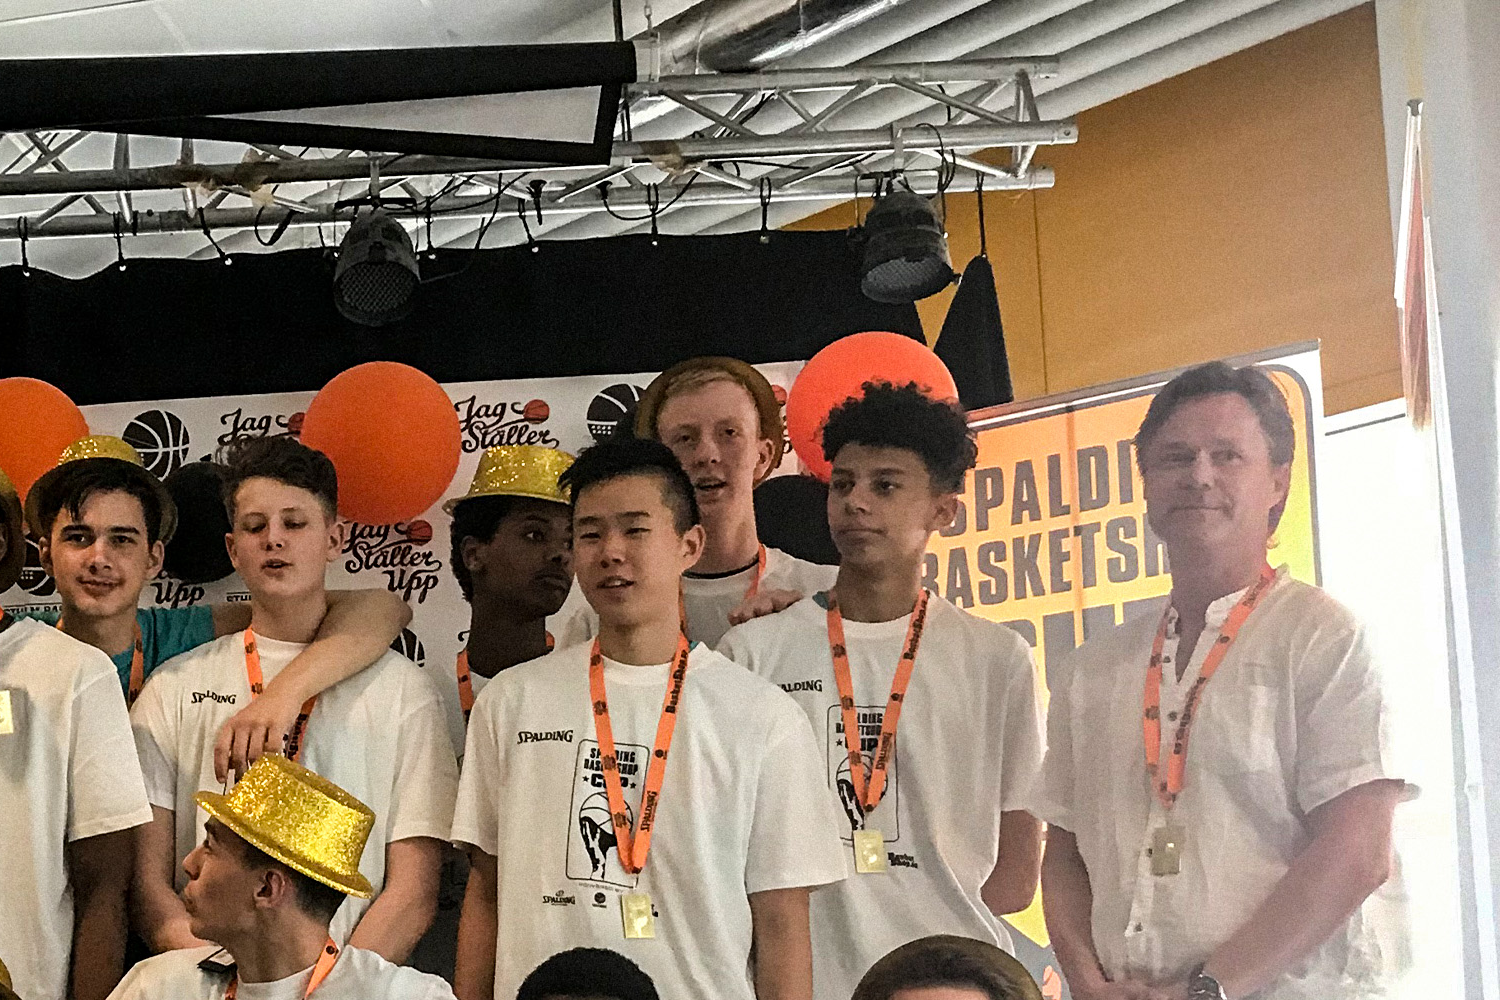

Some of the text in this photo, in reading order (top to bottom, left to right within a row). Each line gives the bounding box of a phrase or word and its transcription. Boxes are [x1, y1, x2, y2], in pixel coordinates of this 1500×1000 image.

[218, 408, 272, 446] Jag
[939, 440, 1134, 537] PALDI
[382, 568, 439, 604] Upp
[517, 729, 574, 745] SPALDING
